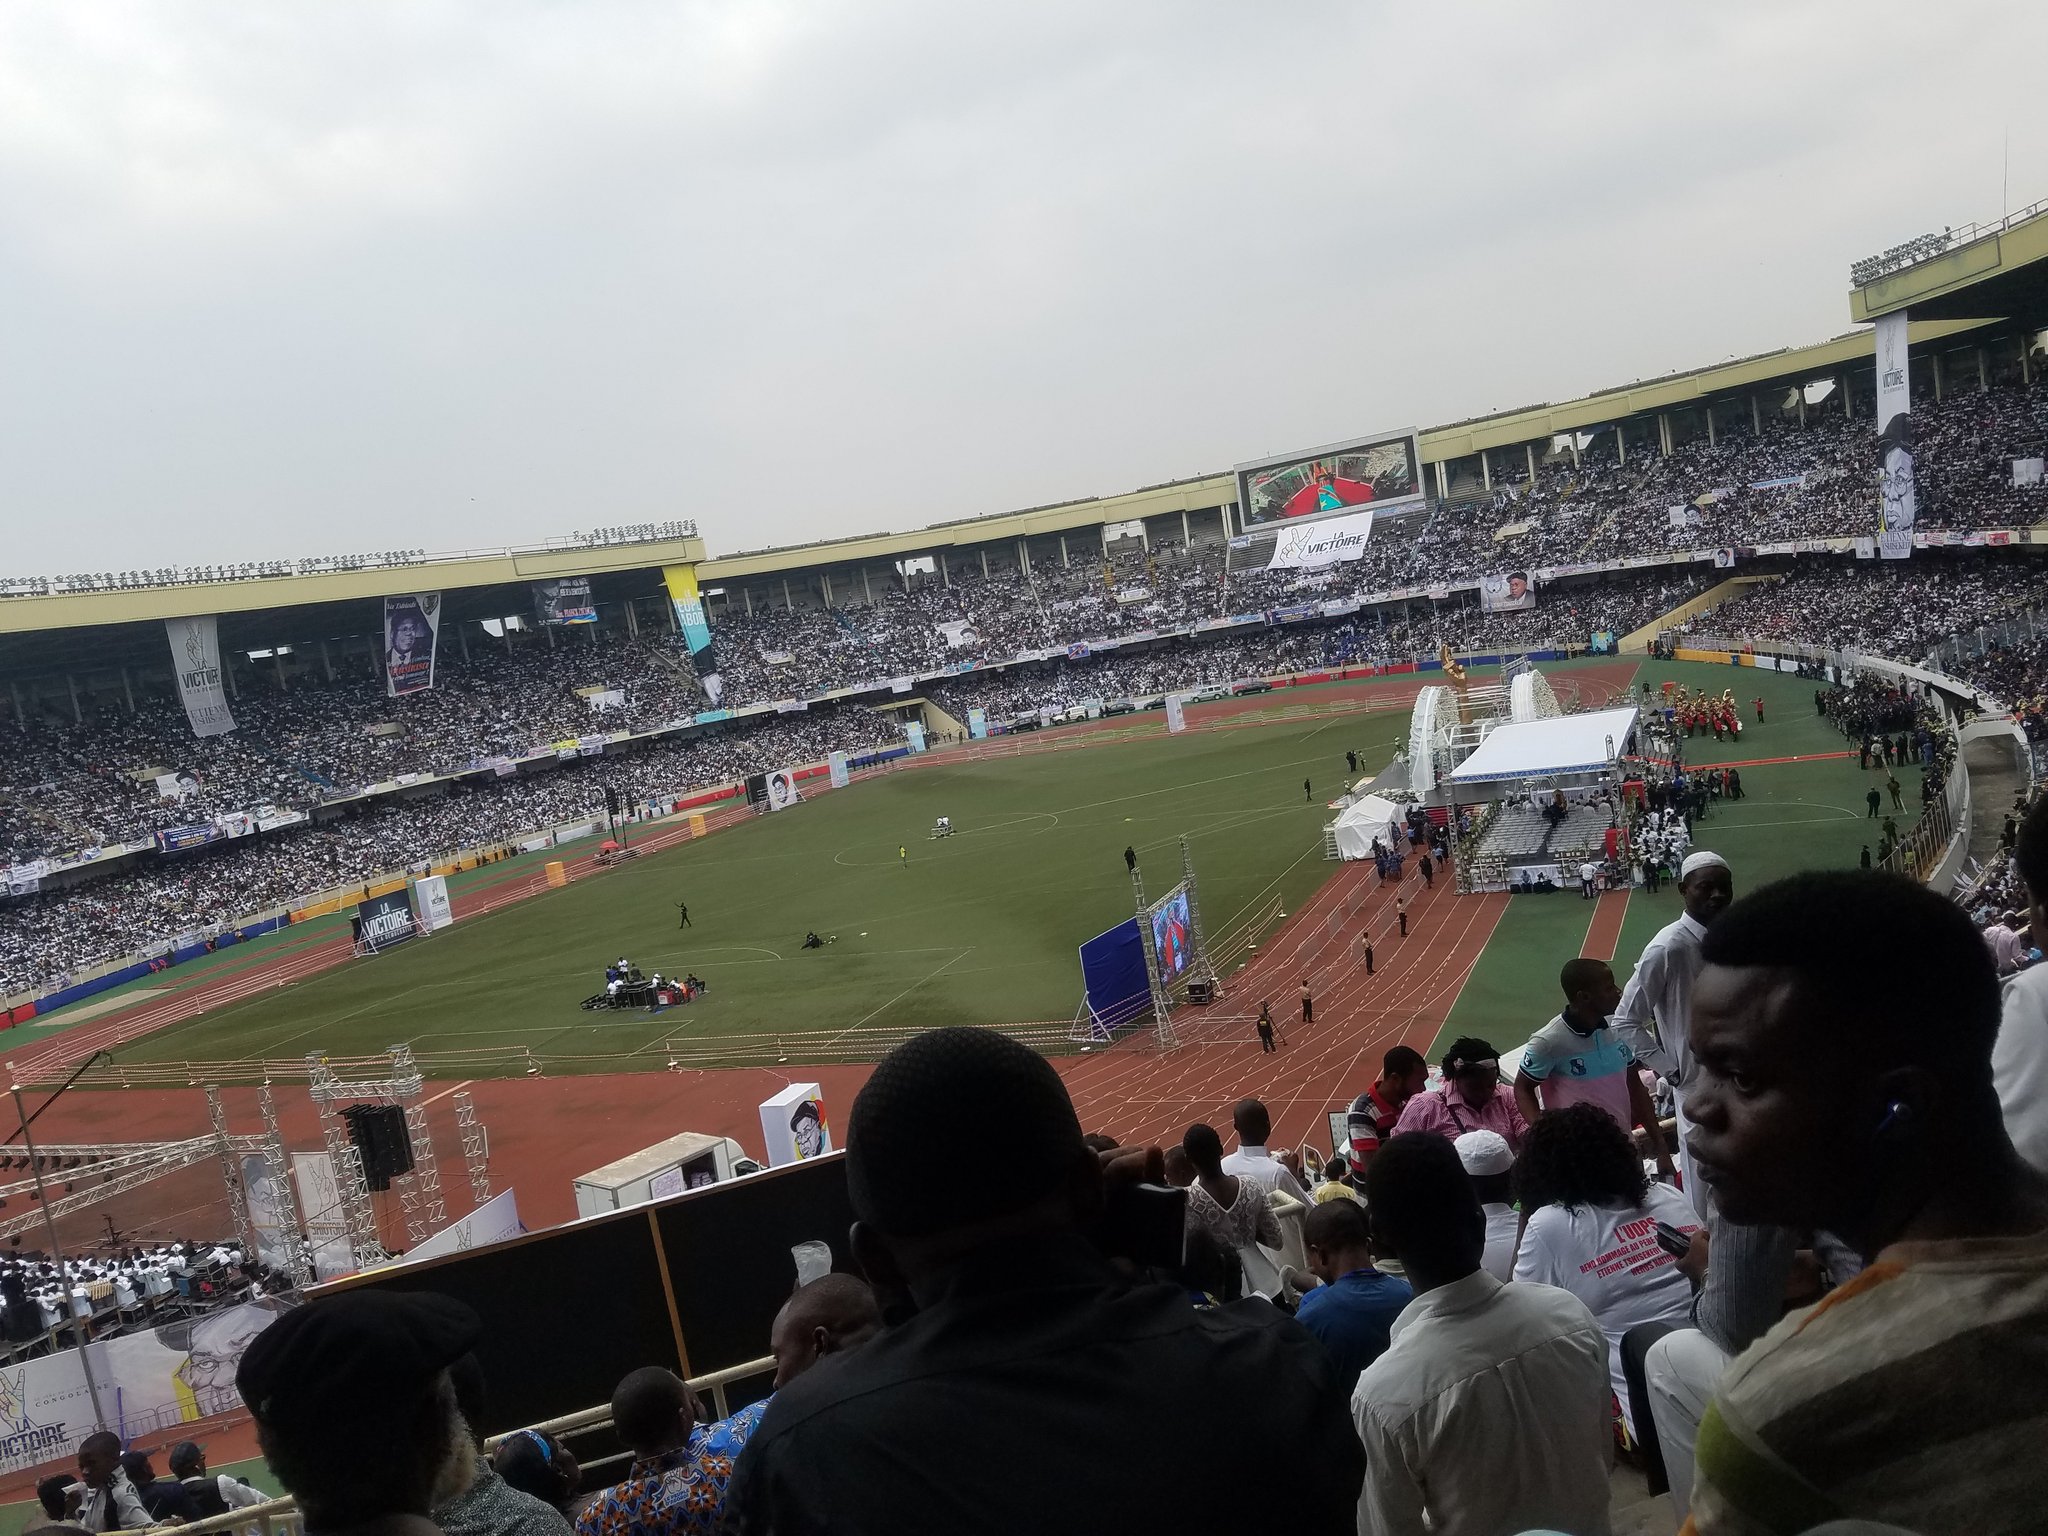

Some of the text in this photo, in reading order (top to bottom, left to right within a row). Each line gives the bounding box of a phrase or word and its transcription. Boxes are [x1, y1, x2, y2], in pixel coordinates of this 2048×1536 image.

[1308, 533, 1365, 554] VICTOIRE
[1333, 531, 1344, 539] LA
[197, 660, 208, 671] LA
[380, 902, 390, 915] LA
[364, 908, 410, 937] VICTOIRE
[1613, 1216, 1659, 1244] L'UDPS
[1579, 1259, 1598, 1274] REND
[1596, 1244, 1631, 1267] HOMMAGE
[1630, 1243, 1640, 1253] AU
[1596, 1248, 1662, 1280] ETIENNE TSHISEKEDI
[35, 1383, 109, 1408] CONGOLASE
[15, 1418, 31, 1434] LA
